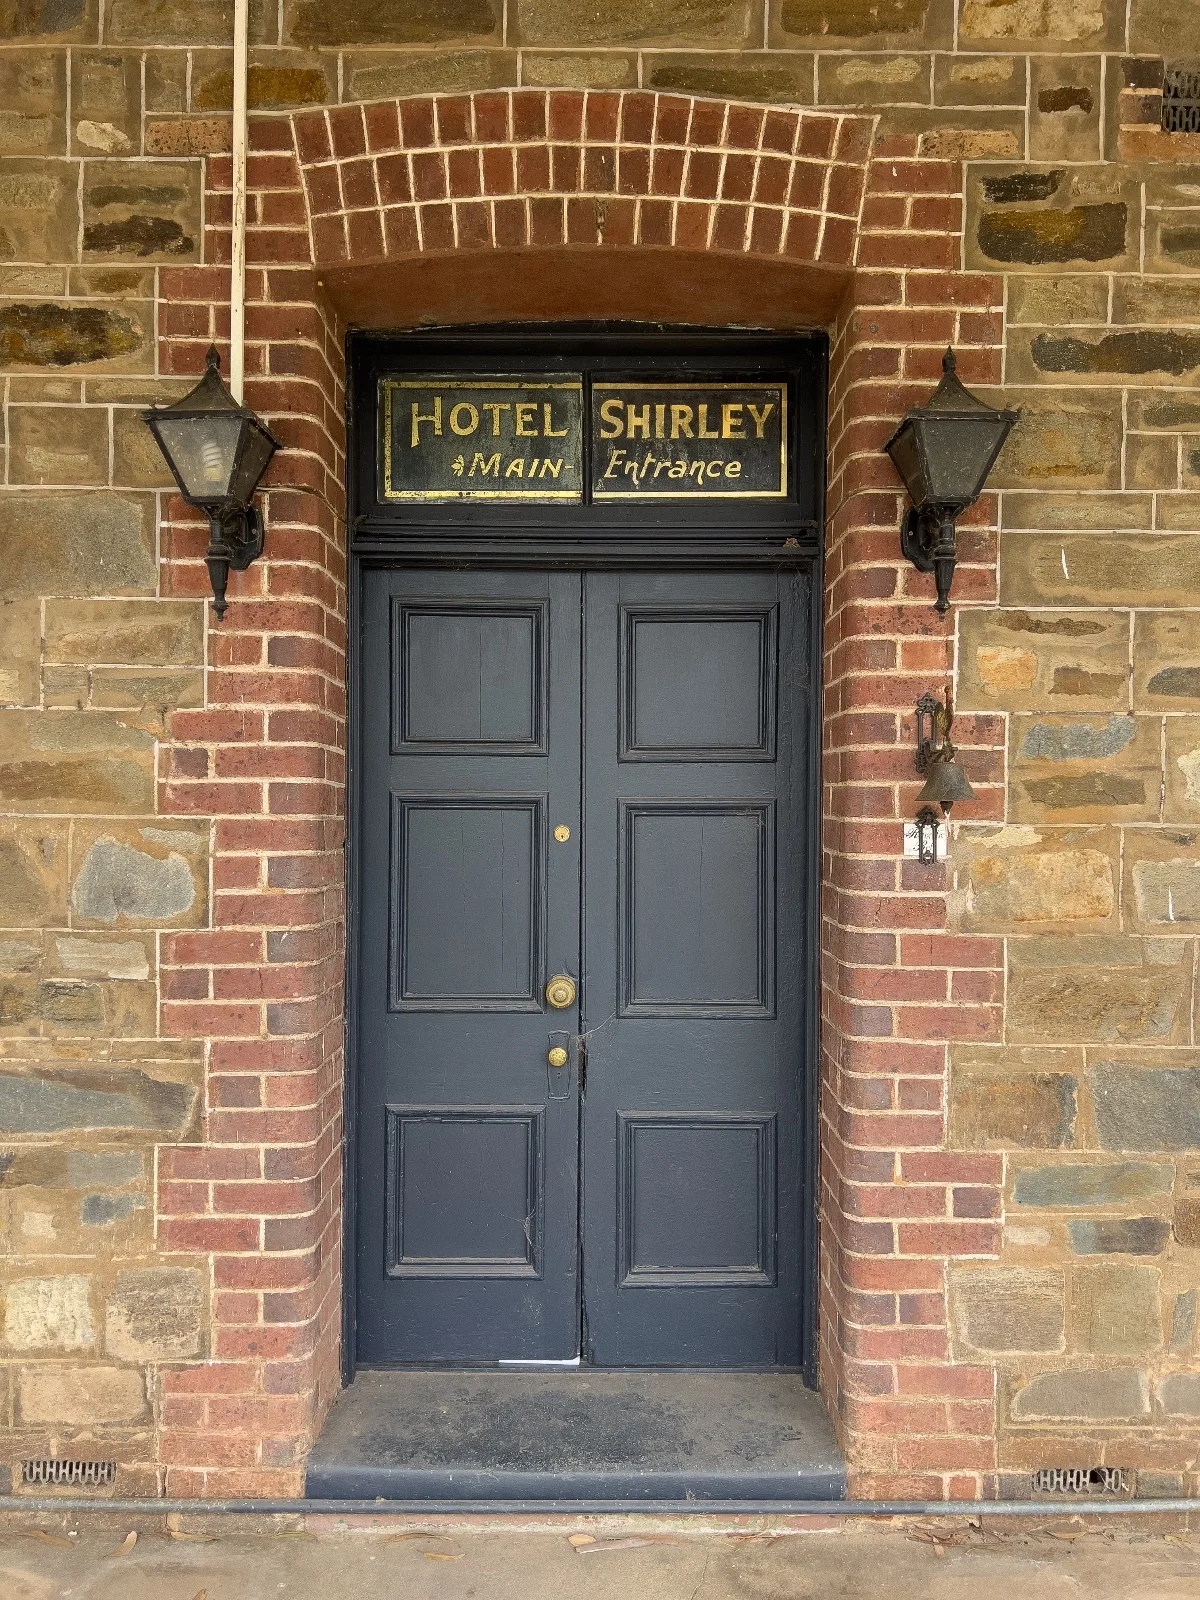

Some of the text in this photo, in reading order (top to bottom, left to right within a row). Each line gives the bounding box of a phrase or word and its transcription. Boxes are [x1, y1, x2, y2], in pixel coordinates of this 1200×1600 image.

[411, 396, 775, 448] HOTEL SHIRLEY
[603, 449, 742, 485] Entrance
